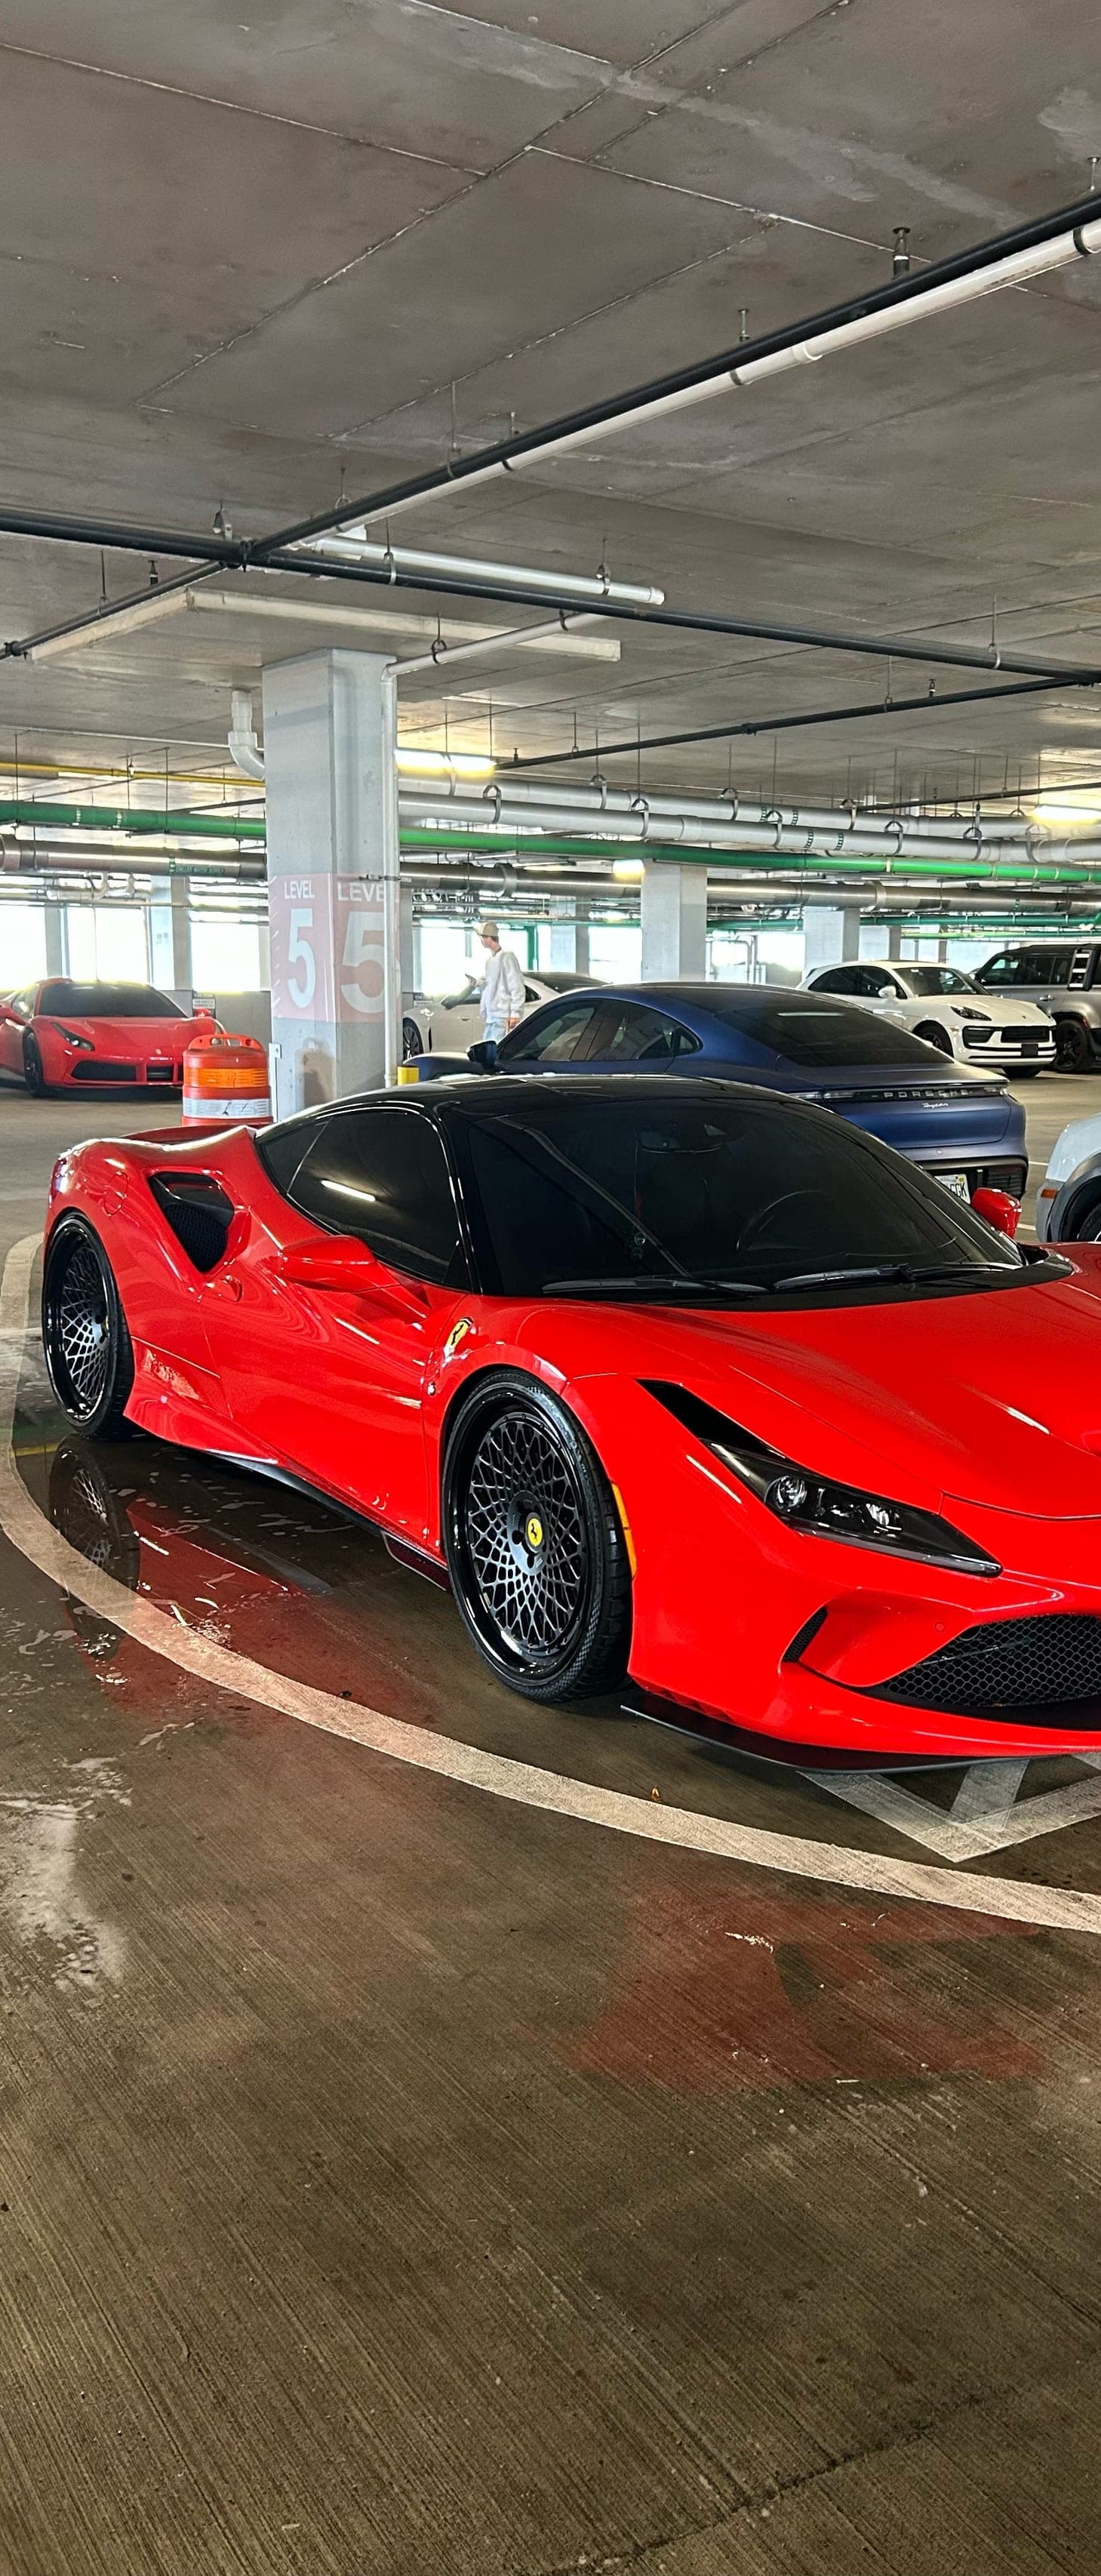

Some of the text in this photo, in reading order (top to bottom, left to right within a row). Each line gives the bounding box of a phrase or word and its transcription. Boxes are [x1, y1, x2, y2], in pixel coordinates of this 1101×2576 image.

[284, 881, 315, 898] LEVEL
[337, 882, 384, 901] LEVE
[288, 908, 315, 1008] 5
[340, 911, 384, 1014] 5
